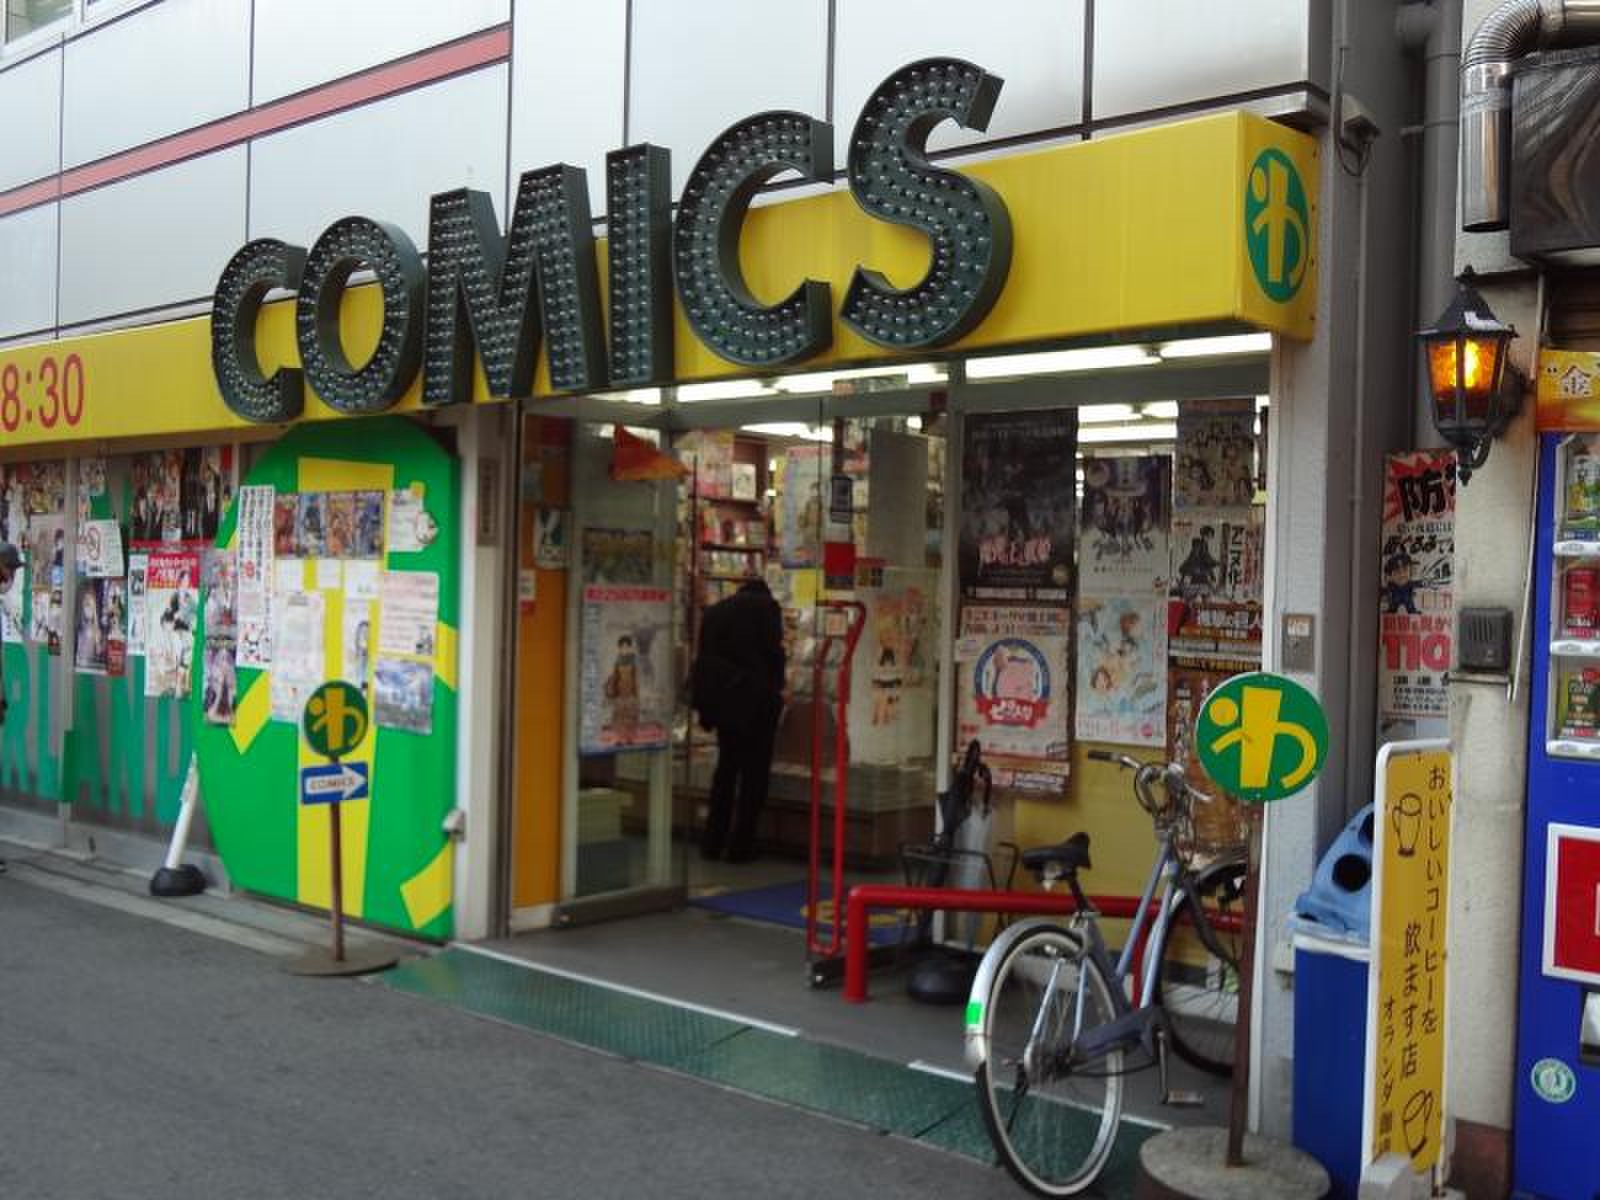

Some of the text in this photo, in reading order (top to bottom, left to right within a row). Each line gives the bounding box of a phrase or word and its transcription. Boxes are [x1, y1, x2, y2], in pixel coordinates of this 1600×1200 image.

[211, 56, 1013, 424] COMICS
[2, 353, 84, 432] 8:30
[1382, 633, 1451, 672] 110
[1422, 766, 1445, 1036] おいしいコーヒーを
